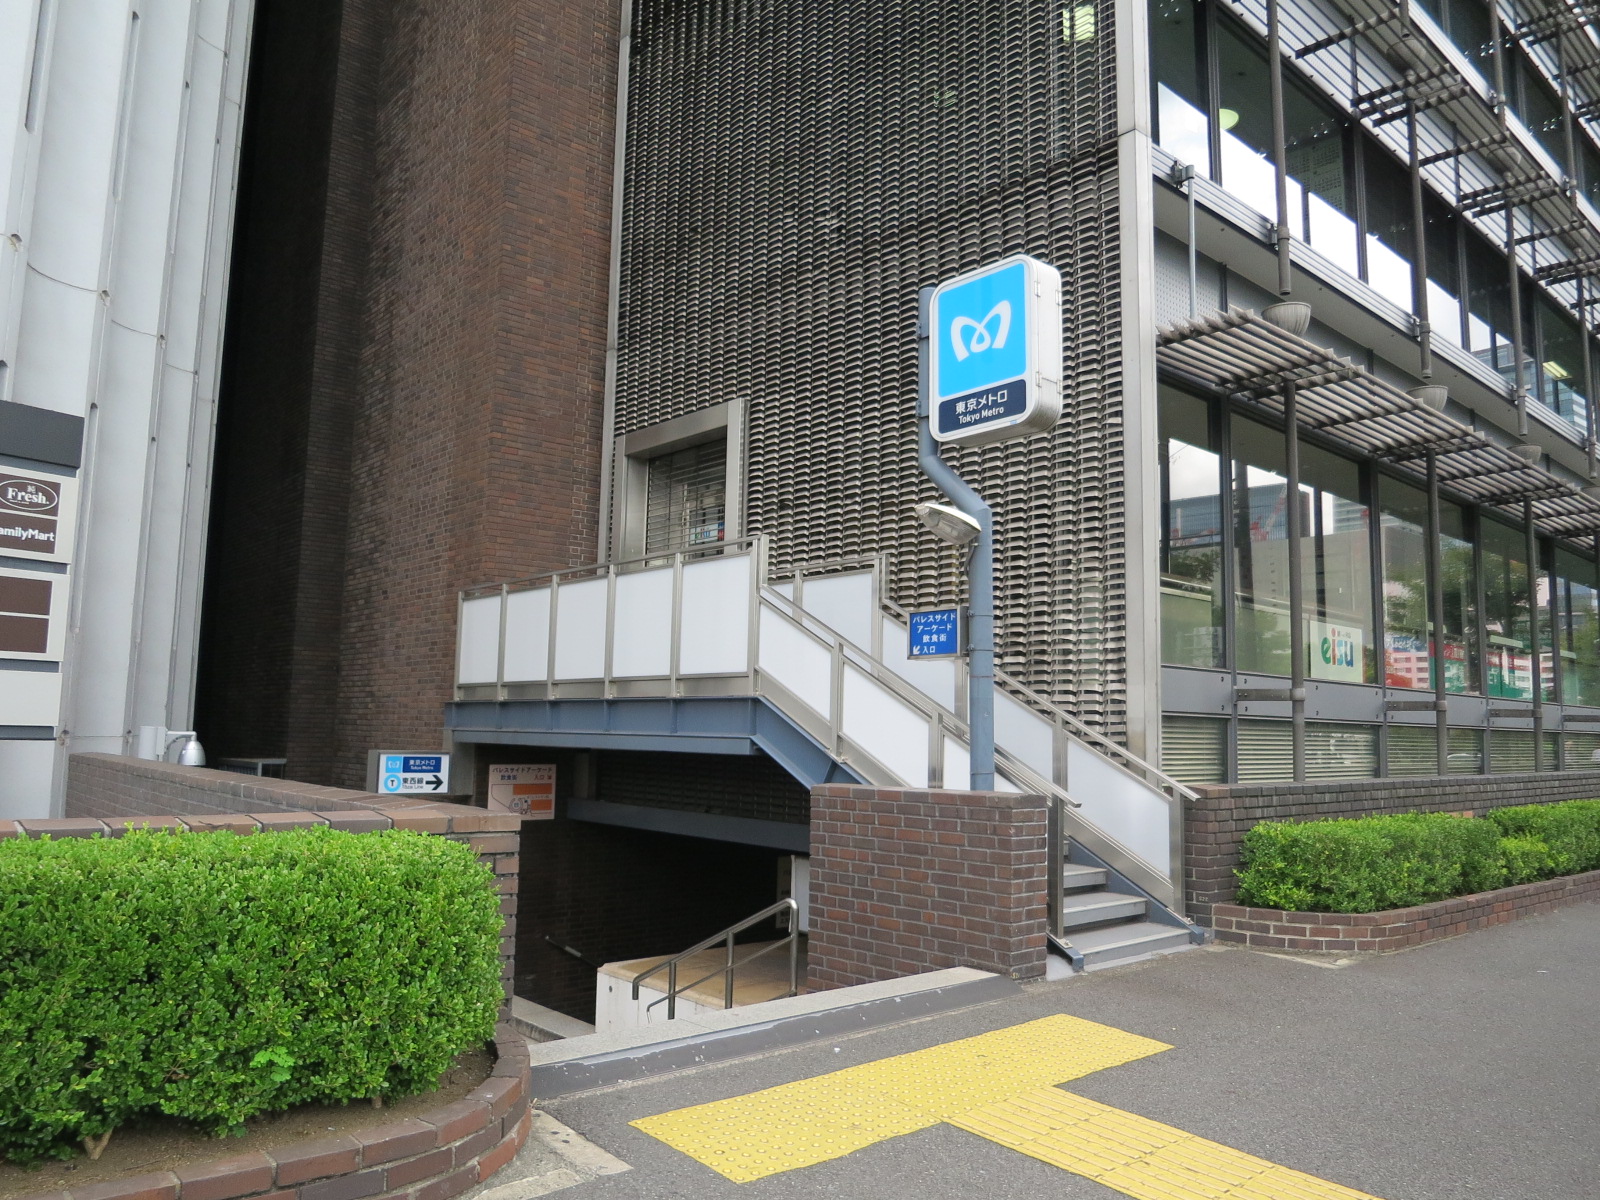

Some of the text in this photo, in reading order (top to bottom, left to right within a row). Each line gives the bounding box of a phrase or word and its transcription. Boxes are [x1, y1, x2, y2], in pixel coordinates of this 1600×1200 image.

[956, 390, 1008, 414] 東京メトロ
[958, 406, 1004, 424] Tokyo Metro
[913, 613, 956, 623] パレスサイド
[917, 623, 952, 633] アーケード
[923, 634, 946, 642] 飲食街
[1320, 627, 1354, 668] eisu
[402, 777, 424, 785] 東西線
